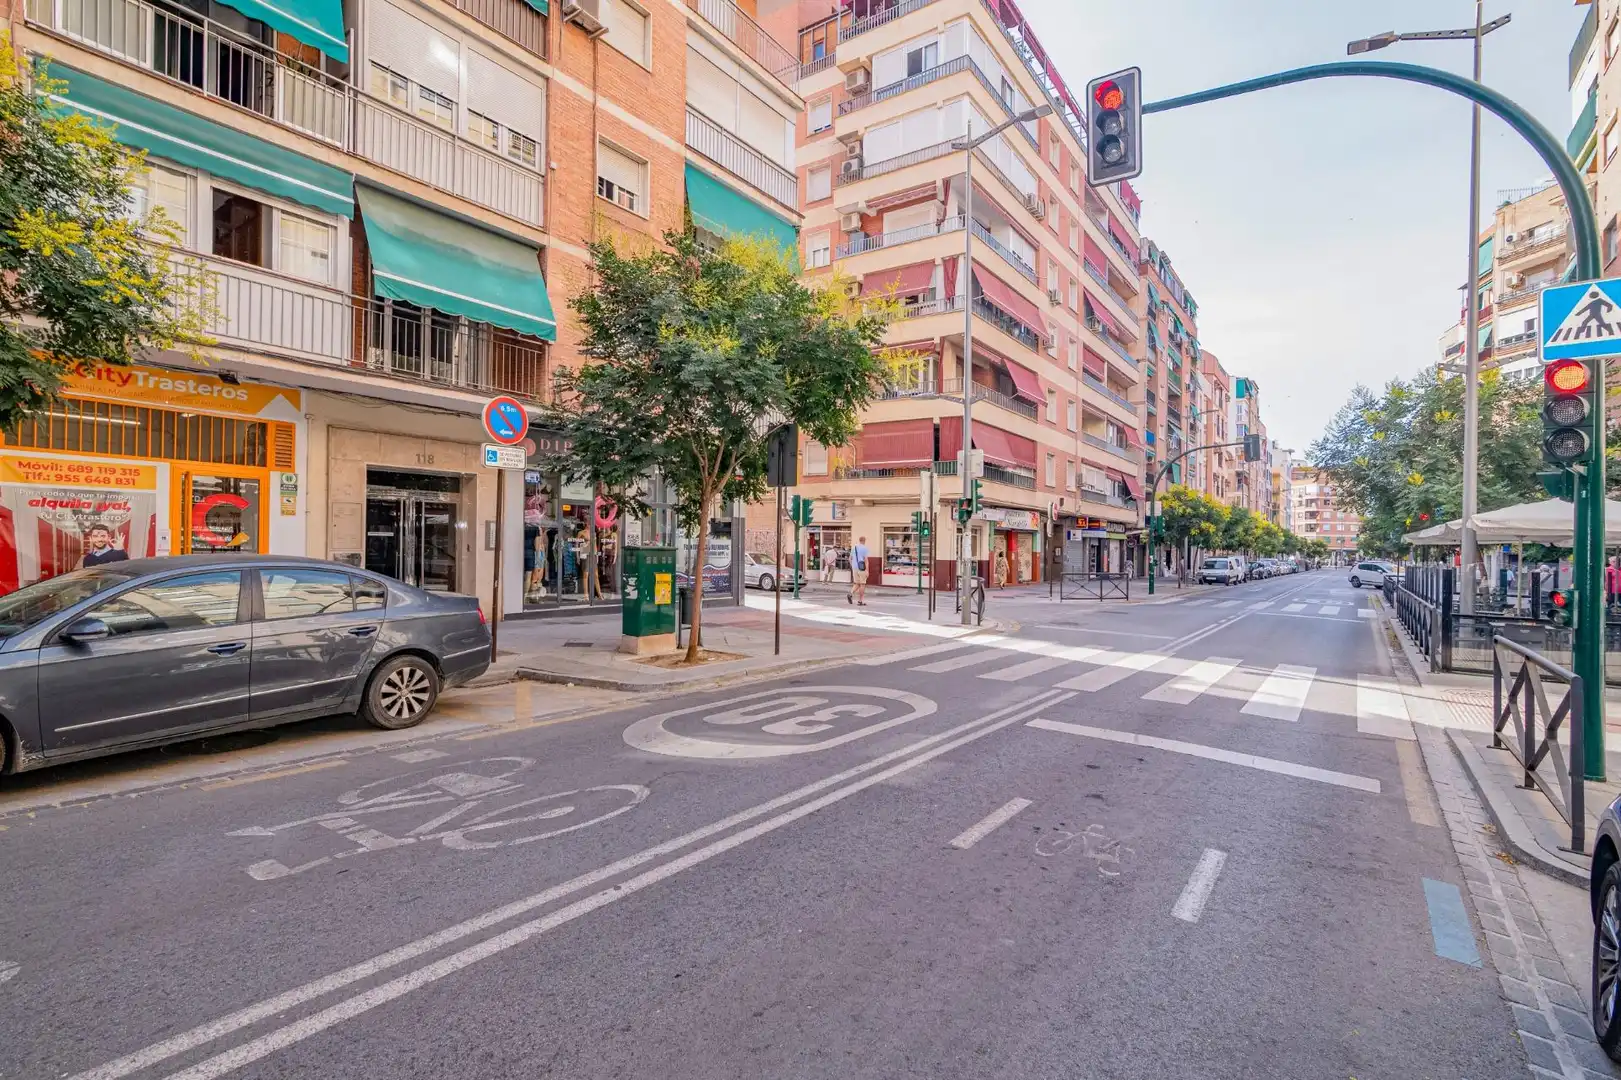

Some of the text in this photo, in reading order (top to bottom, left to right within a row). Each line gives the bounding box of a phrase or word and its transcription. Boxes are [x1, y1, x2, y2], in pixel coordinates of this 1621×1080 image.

[415, 453, 435, 465] 118
[18, 460, 141, 477] Móvil: 689 119 315
[23, 471, 137, 486] Tlf.: 955 648 831
[28, 496, 93, 510] alquila
